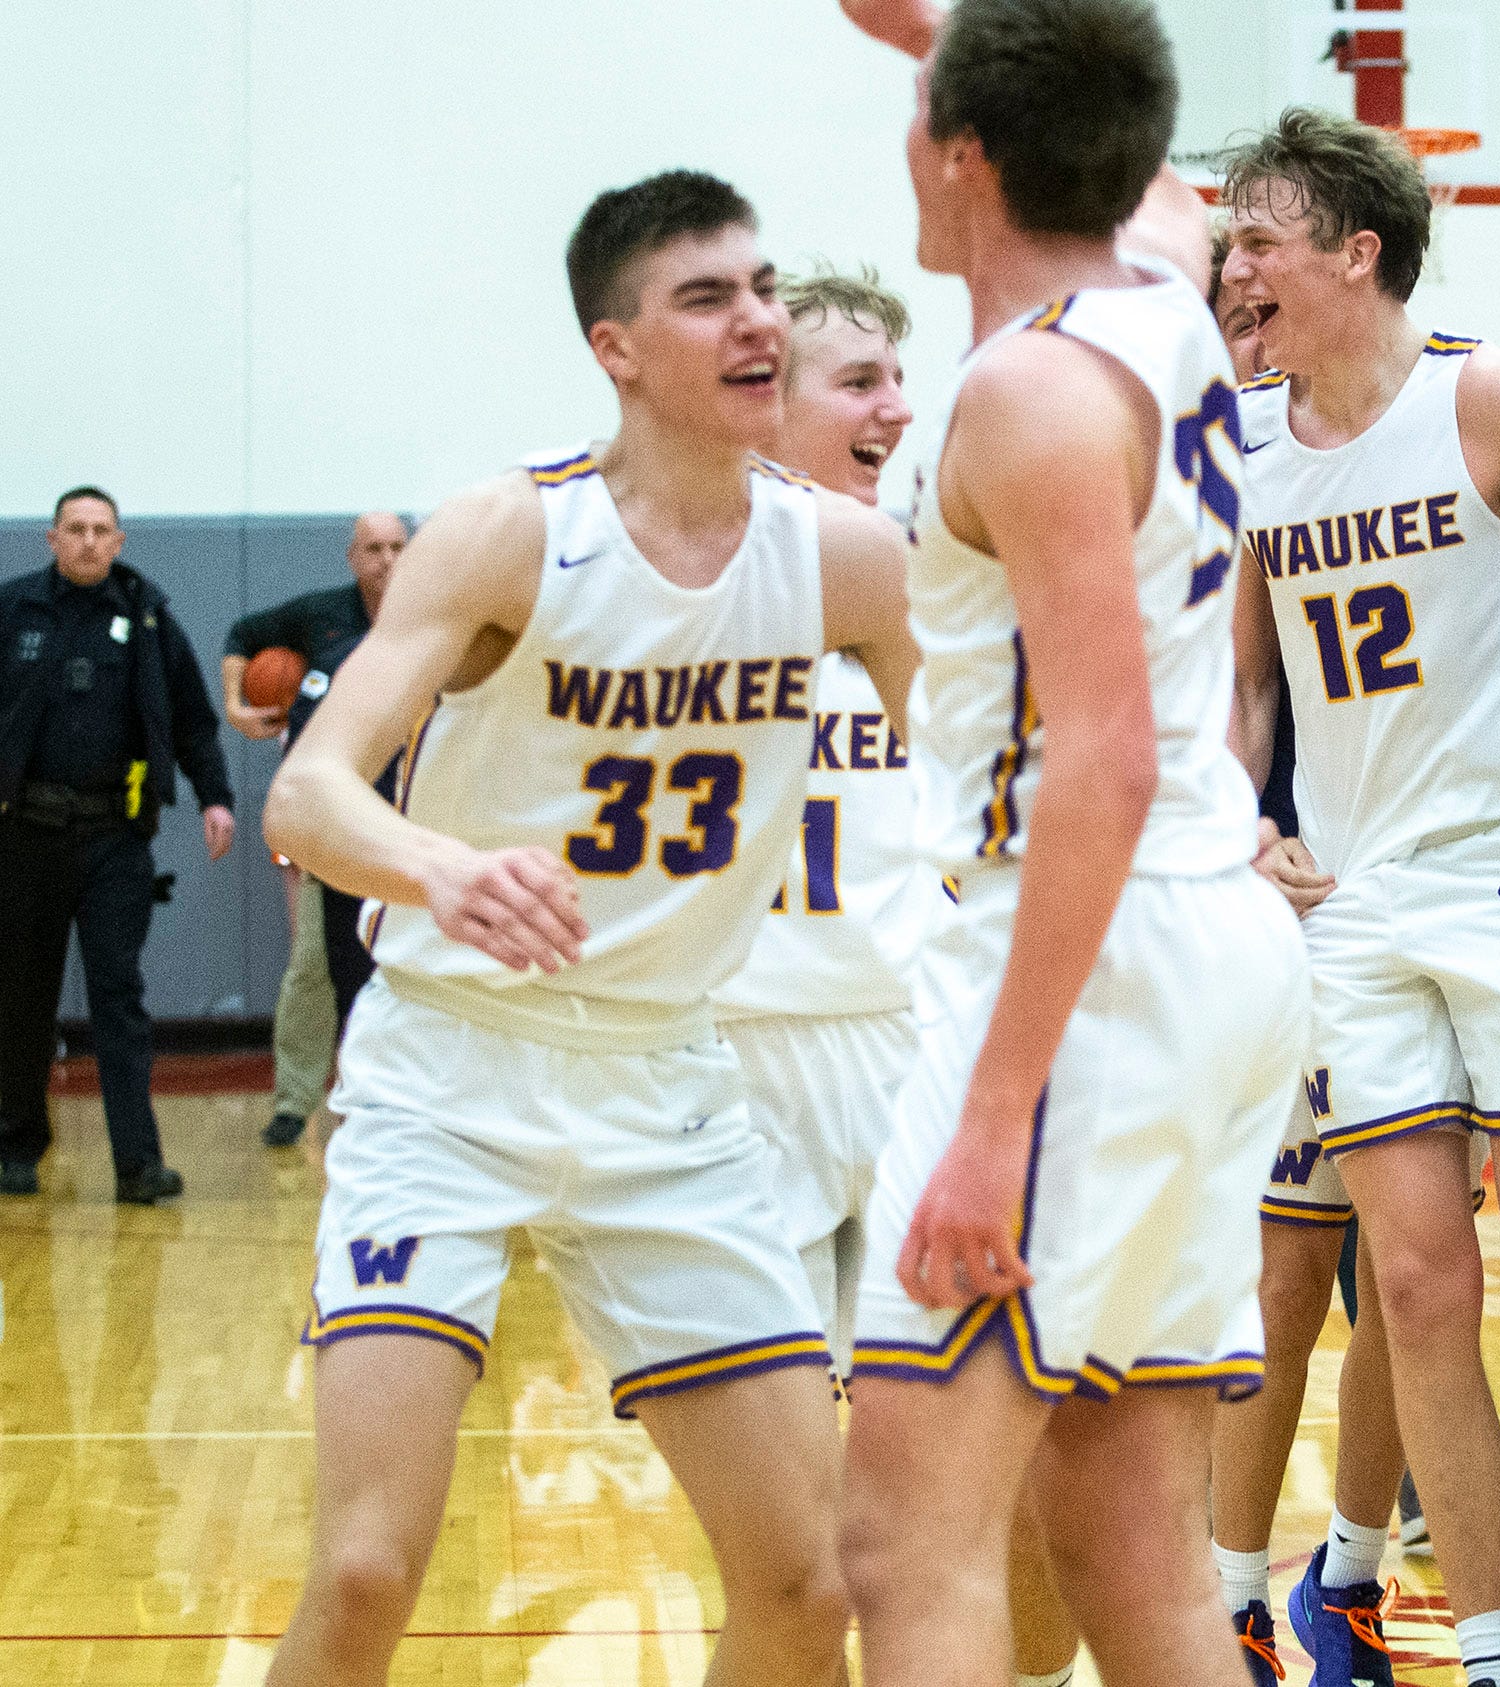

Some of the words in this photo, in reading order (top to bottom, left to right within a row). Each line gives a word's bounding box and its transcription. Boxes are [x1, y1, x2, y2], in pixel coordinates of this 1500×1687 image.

[1246, 491, 1466, 582] WAUKEE
[1300, 580, 1425, 704] 12
[543, 655, 815, 731] WAUKEE
[563, 748, 746, 881] 33
[347, 1233, 424, 1292] W
